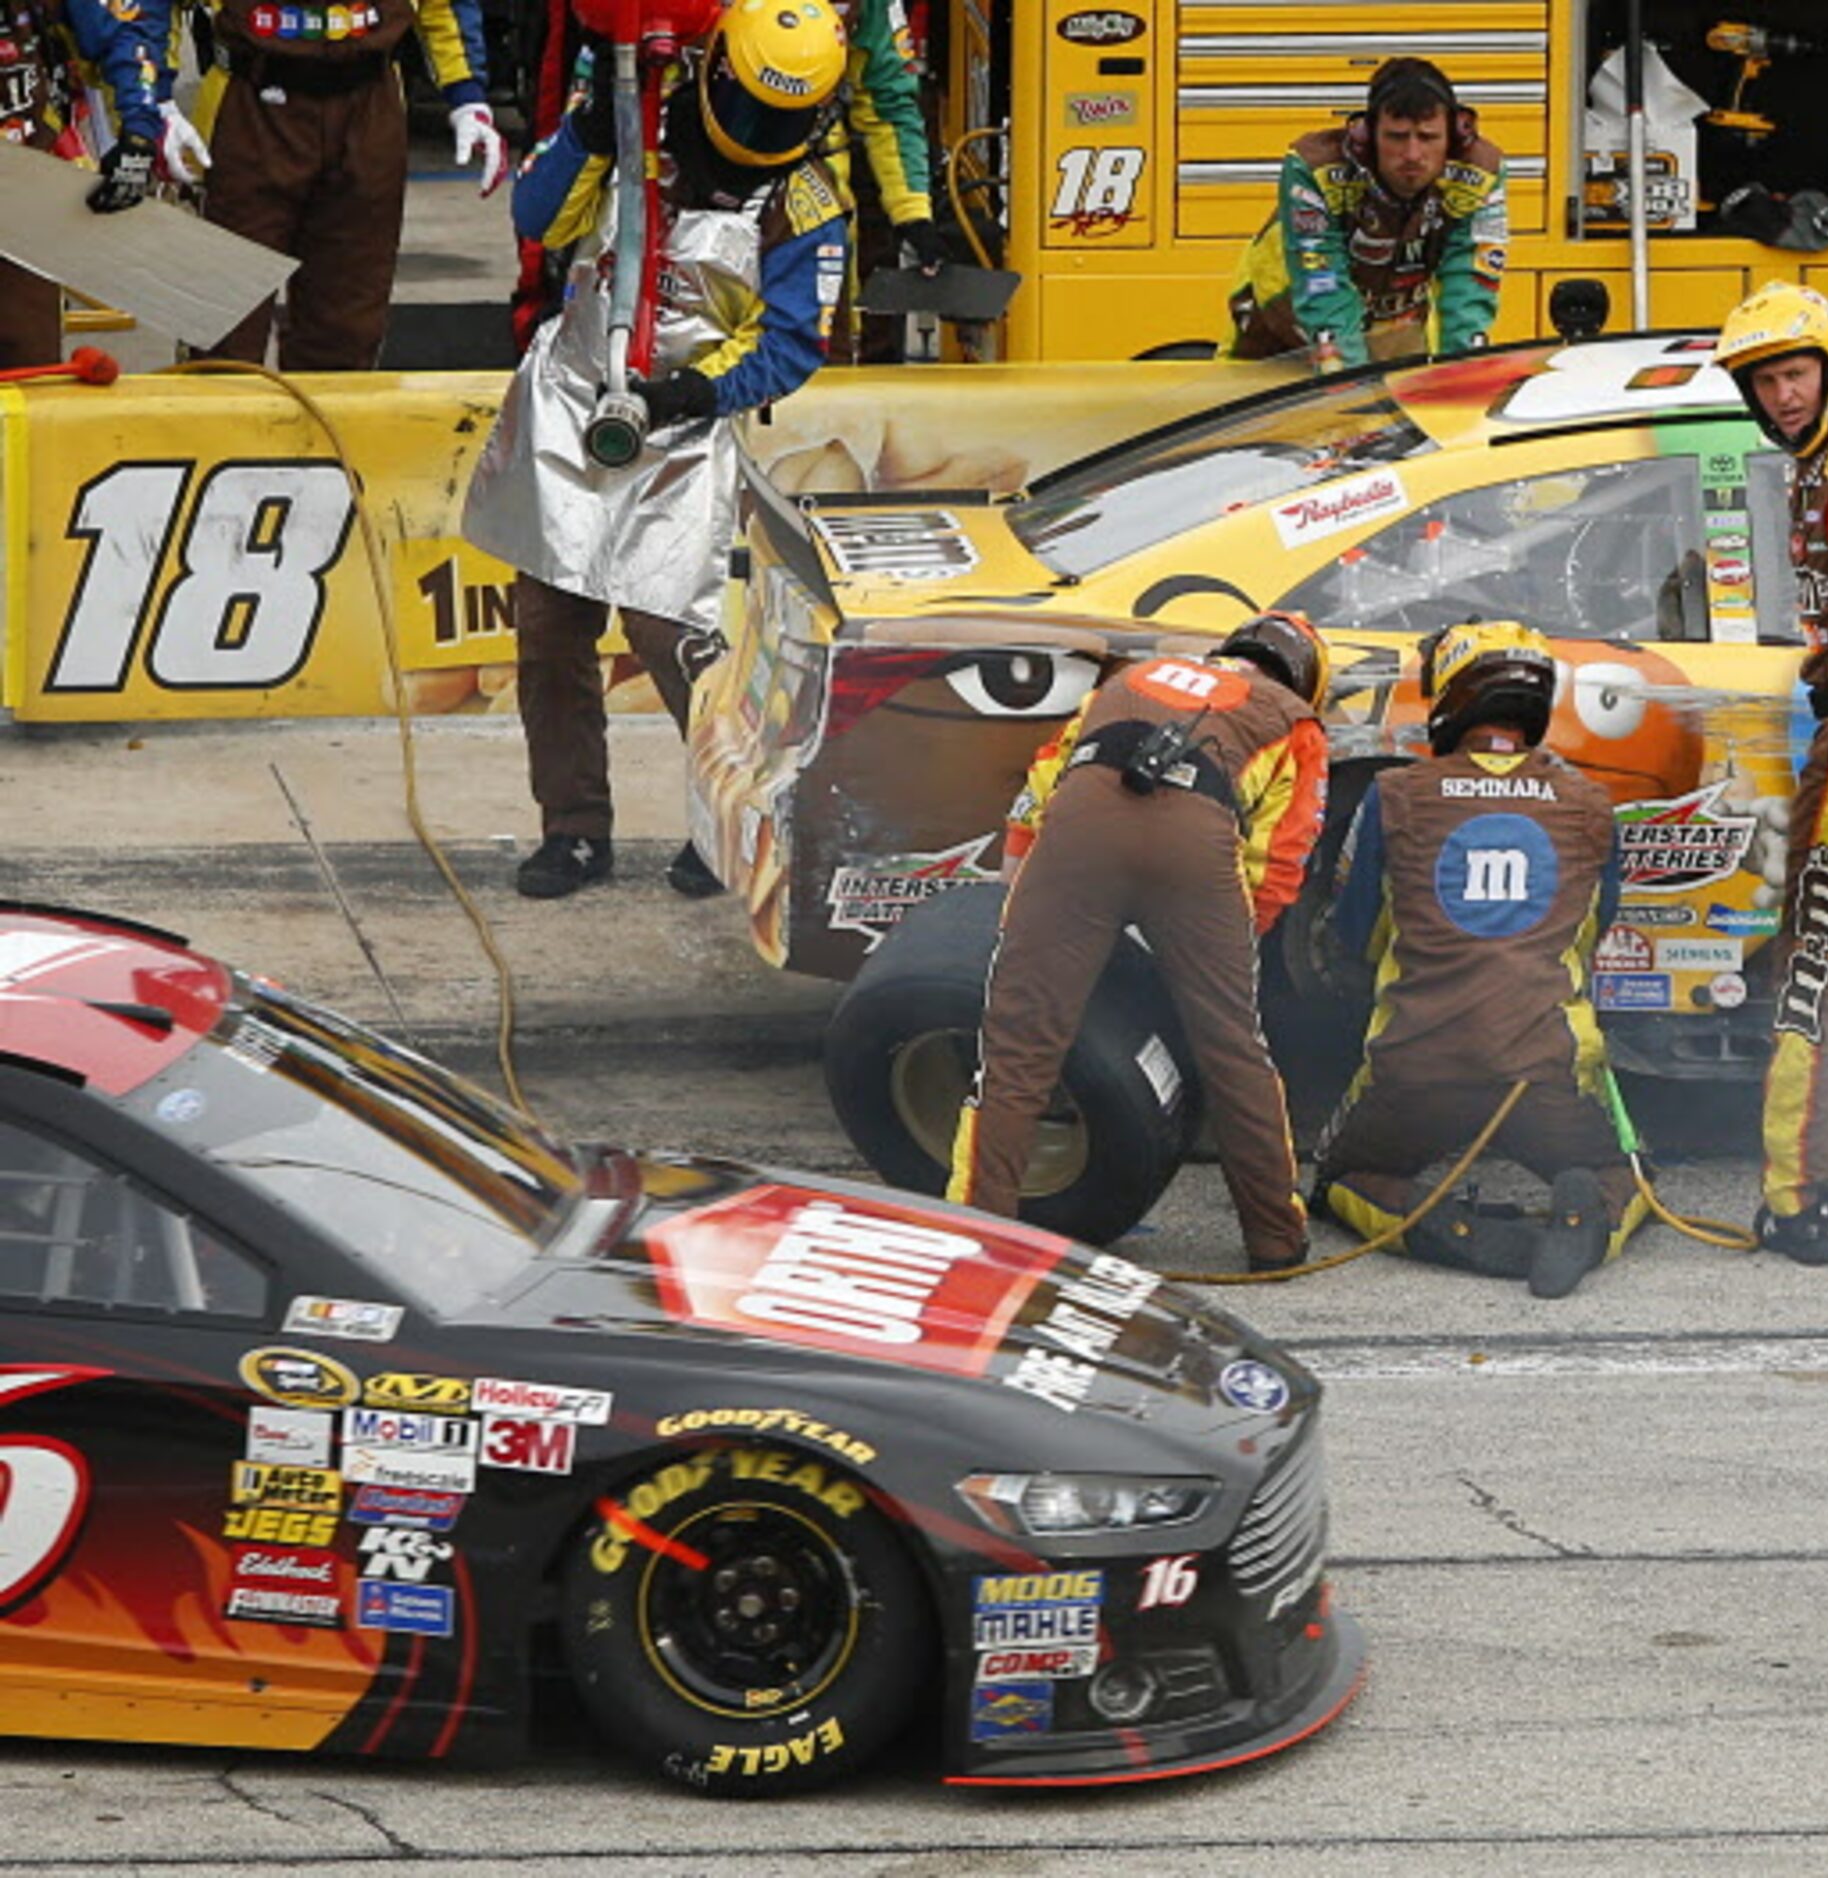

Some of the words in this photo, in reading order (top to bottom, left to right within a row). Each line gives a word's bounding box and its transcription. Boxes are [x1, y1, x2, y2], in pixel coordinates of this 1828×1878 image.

[1049, 147, 1146, 218] 18
[42, 458, 365, 694] 18
[417, 553, 462, 647] 1
[1441, 778, 1557, 801] SEMINARA
[1622, 825, 1748, 846] ERSTATE
[1463, 848, 1528, 900] m
[736, 1200, 982, 1345] ORTHO
[478, 1382, 561, 1414] Holley
[353, 1412, 435, 1444] Mobil
[442, 1420, 469, 1448] 1
[486, 1420, 570, 1468] 3M
[656, 1408, 877, 1465] GOODYEAR
[223, 1509, 339, 1547] JEGS
[978, 1571, 1101, 1603] MOOG
[1138, 1553, 1200, 1610] 16
[978, 1609, 1094, 1643] MAHLE
[706, 1716, 847, 1777] EAGLE
